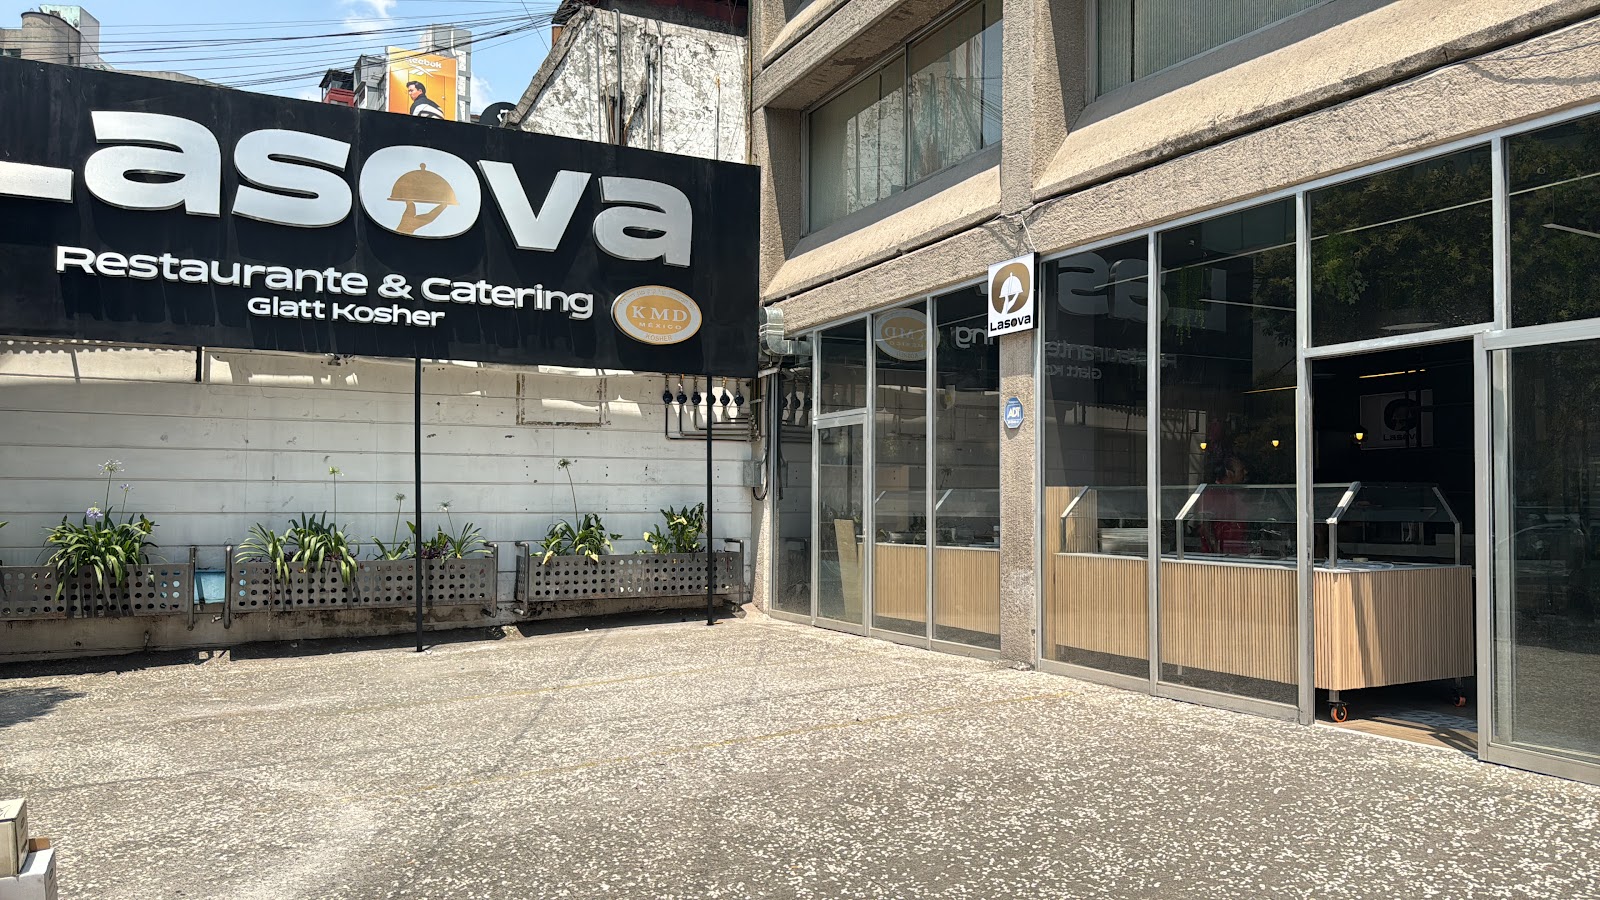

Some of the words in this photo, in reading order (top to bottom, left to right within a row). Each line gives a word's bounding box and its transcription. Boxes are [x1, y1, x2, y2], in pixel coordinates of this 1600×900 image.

[56, 245, 369, 295] Restaurante
[378, 273, 414, 300] &
[420, 277, 594, 320] Catering
[247, 296, 325, 319] Glatt
[331, 302, 446, 326] Kosher
[631, 305, 688, 322] KMD
[990, 314, 1031, 332] Lasova
[645, 333, 673, 342] KOSHER
[1007, 406, 1020, 418] ADT
